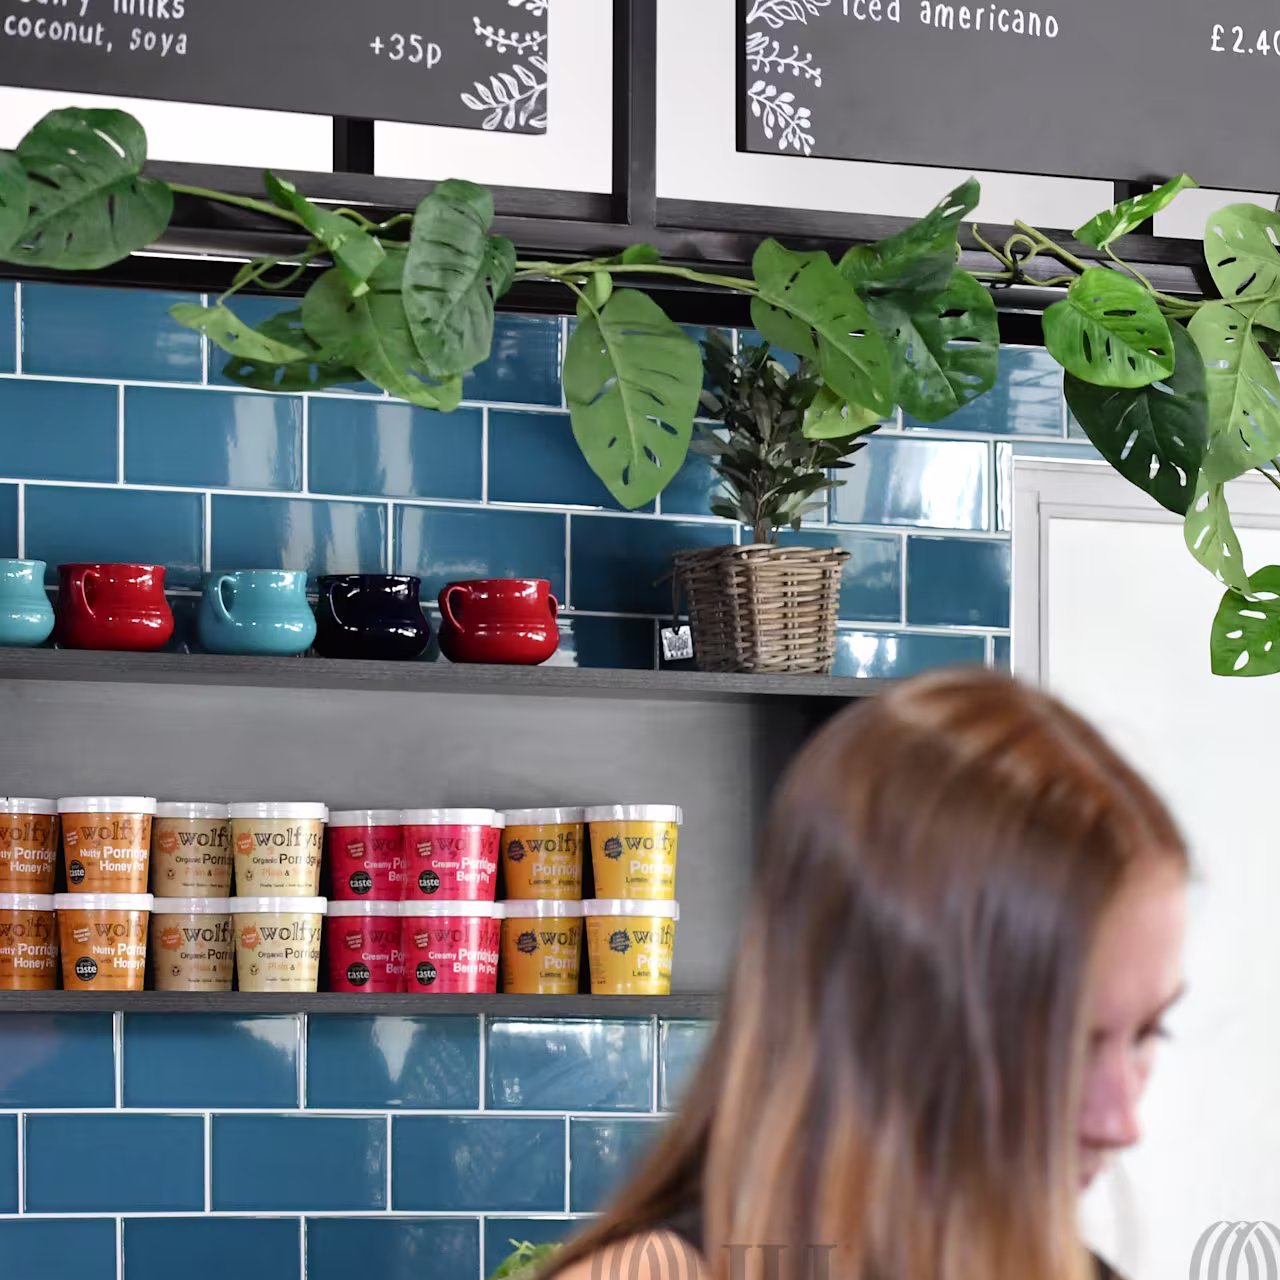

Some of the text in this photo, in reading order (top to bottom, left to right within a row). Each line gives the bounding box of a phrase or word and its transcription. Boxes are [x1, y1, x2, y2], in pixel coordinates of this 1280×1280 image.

[919, 0, 1059, 38] americano
[4, 14, 442, 69] coconut, soya +35p
[347, 971, 370, 980] taste
[416, 970, 437, 979] taste
